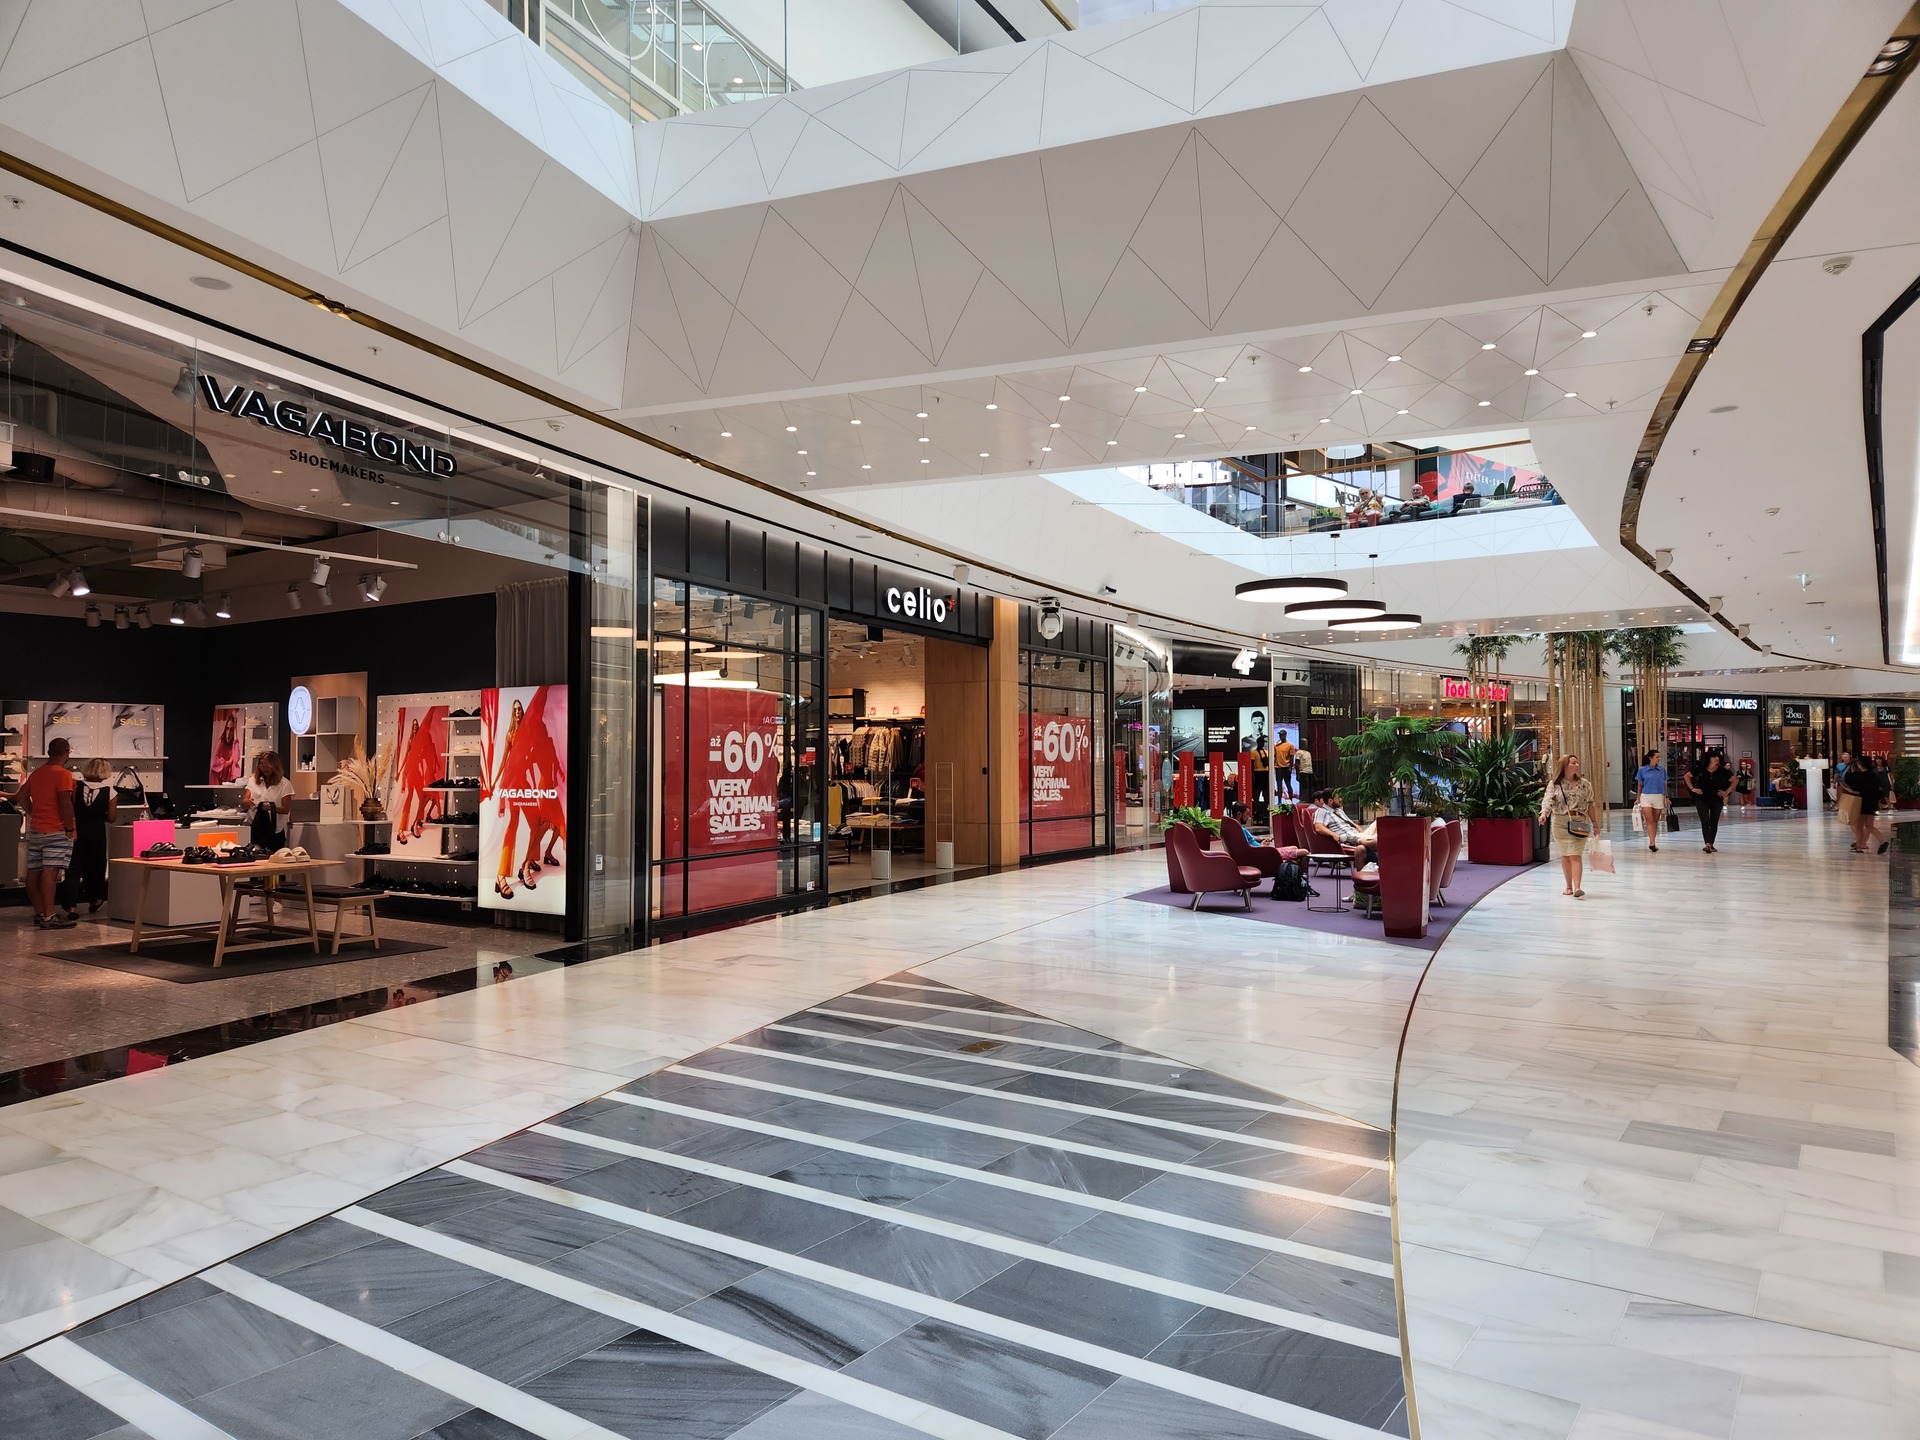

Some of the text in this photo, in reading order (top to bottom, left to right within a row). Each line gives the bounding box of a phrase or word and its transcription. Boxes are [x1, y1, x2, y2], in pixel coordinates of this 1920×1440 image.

[197, 374, 458, 479] VAGABOND
[289, 448, 386, 485] SHOEMAKERS
[886, 586, 946, 623] celio
[1232, 649, 1258, 676] 4F
[1443, 677, 1470, 699] Foot
[1702, 698, 1724, 709] JACK
[1732, 699, 1758, 710] JONES
[53, 715, 80, 725] SALE
[120, 718, 147, 727] SALE
[710, 735, 721, 747] až
[1033, 721, 1089, 762] -60%
[709, 730, 779, 773] -60%
[1033, 765, 1055, 777] VERY
[708, 778, 752, 797] VERY
[1034, 778, 1070, 789] NORMAL
[495, 788, 558, 800] VAGABOND
[1033, 789, 1064, 802] SALES.
[709, 796, 775, 815] NORMAL
[709, 813, 765, 835] SALES.
